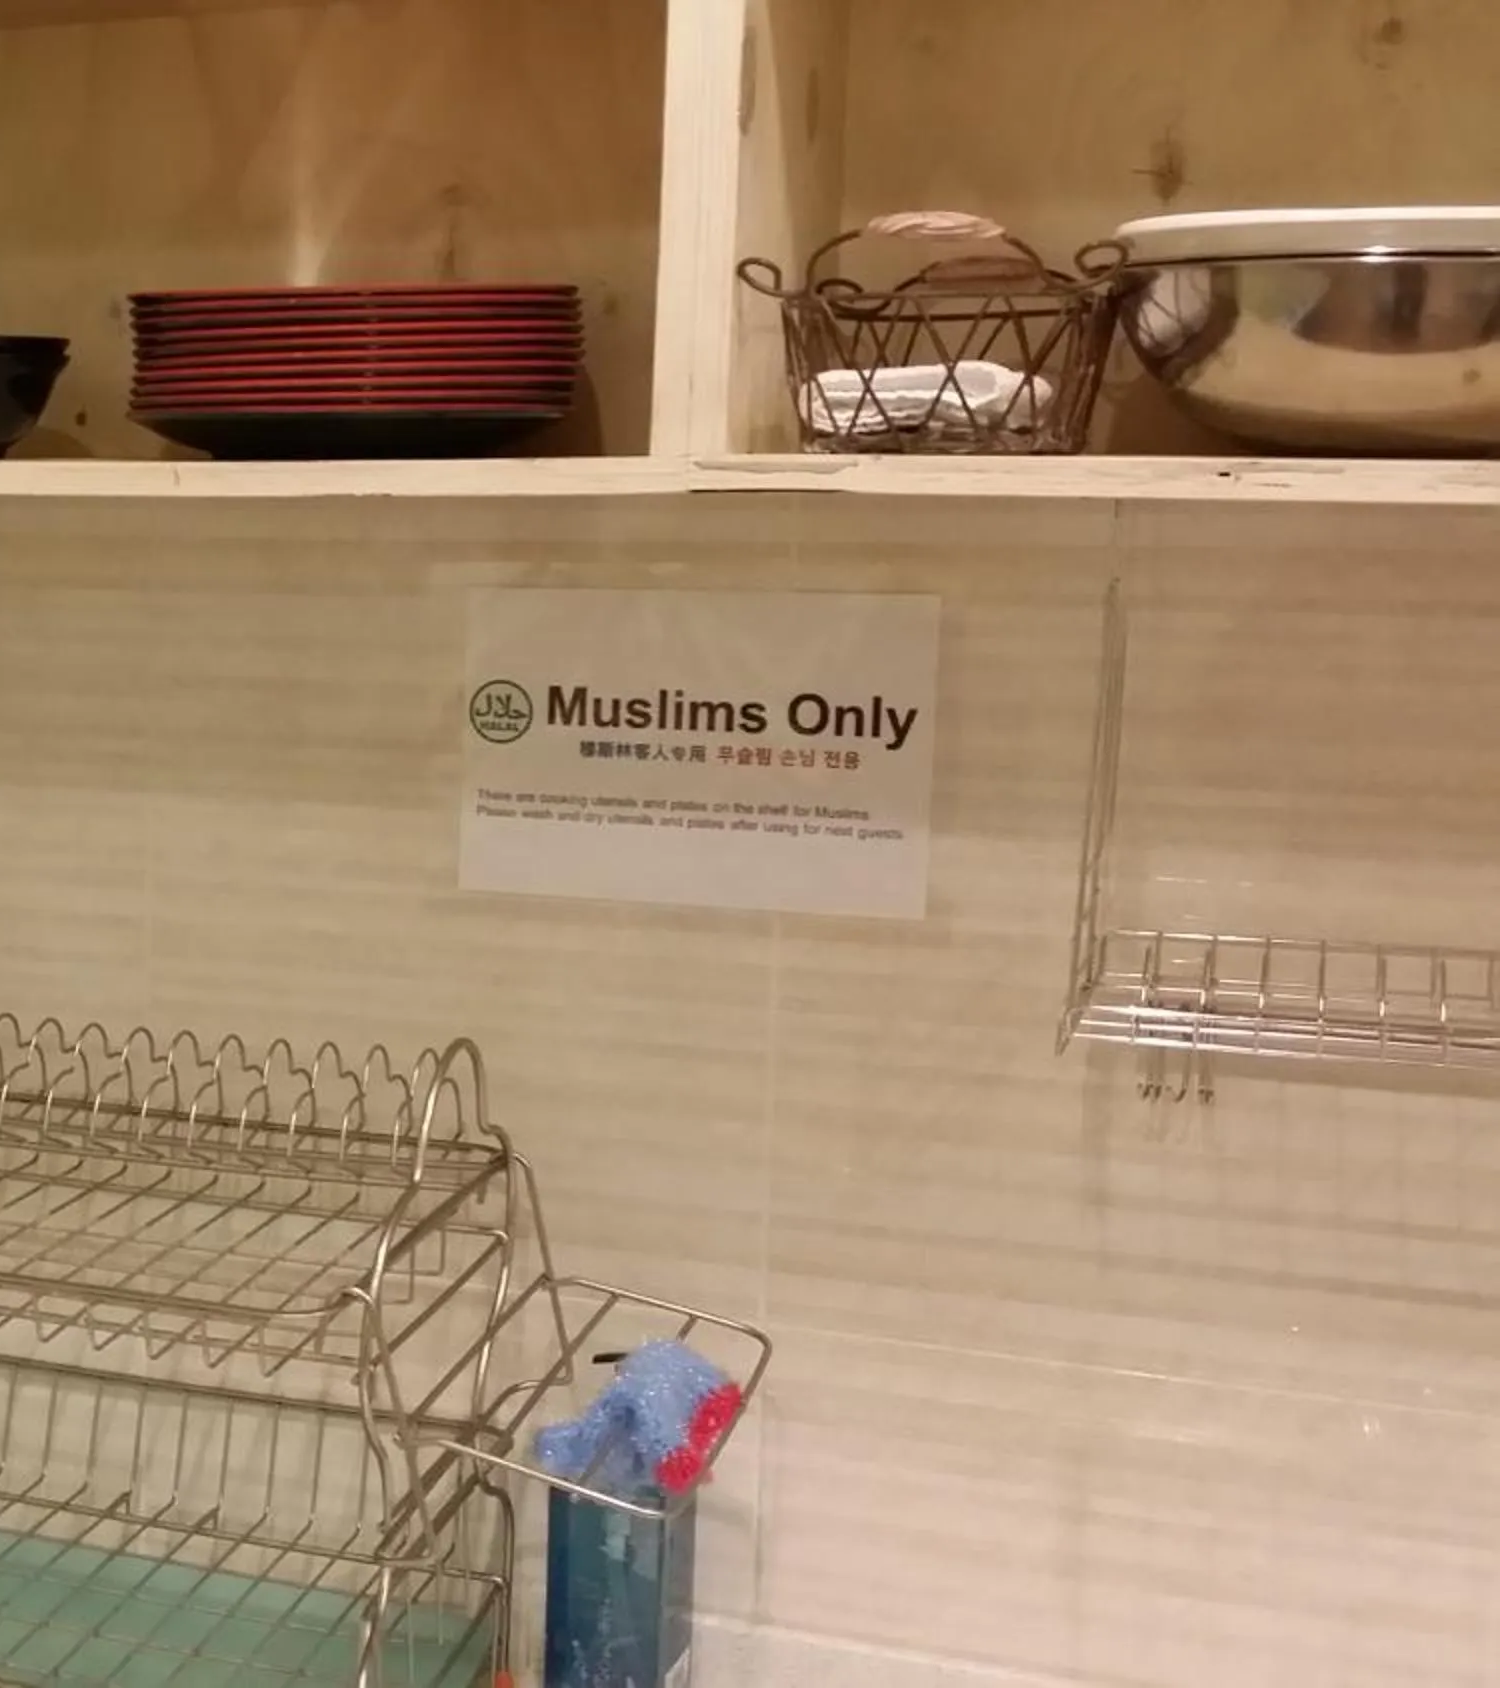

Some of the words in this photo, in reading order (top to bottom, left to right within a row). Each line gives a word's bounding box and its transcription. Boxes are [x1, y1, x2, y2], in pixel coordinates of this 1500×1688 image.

[547, 686, 768, 734] Muslims
[788, 693, 918, 750] Only
[717, 745, 771, 766] 무슬림
[780, 748, 816, 768] 손님
[824, 750, 860, 769] 전용
